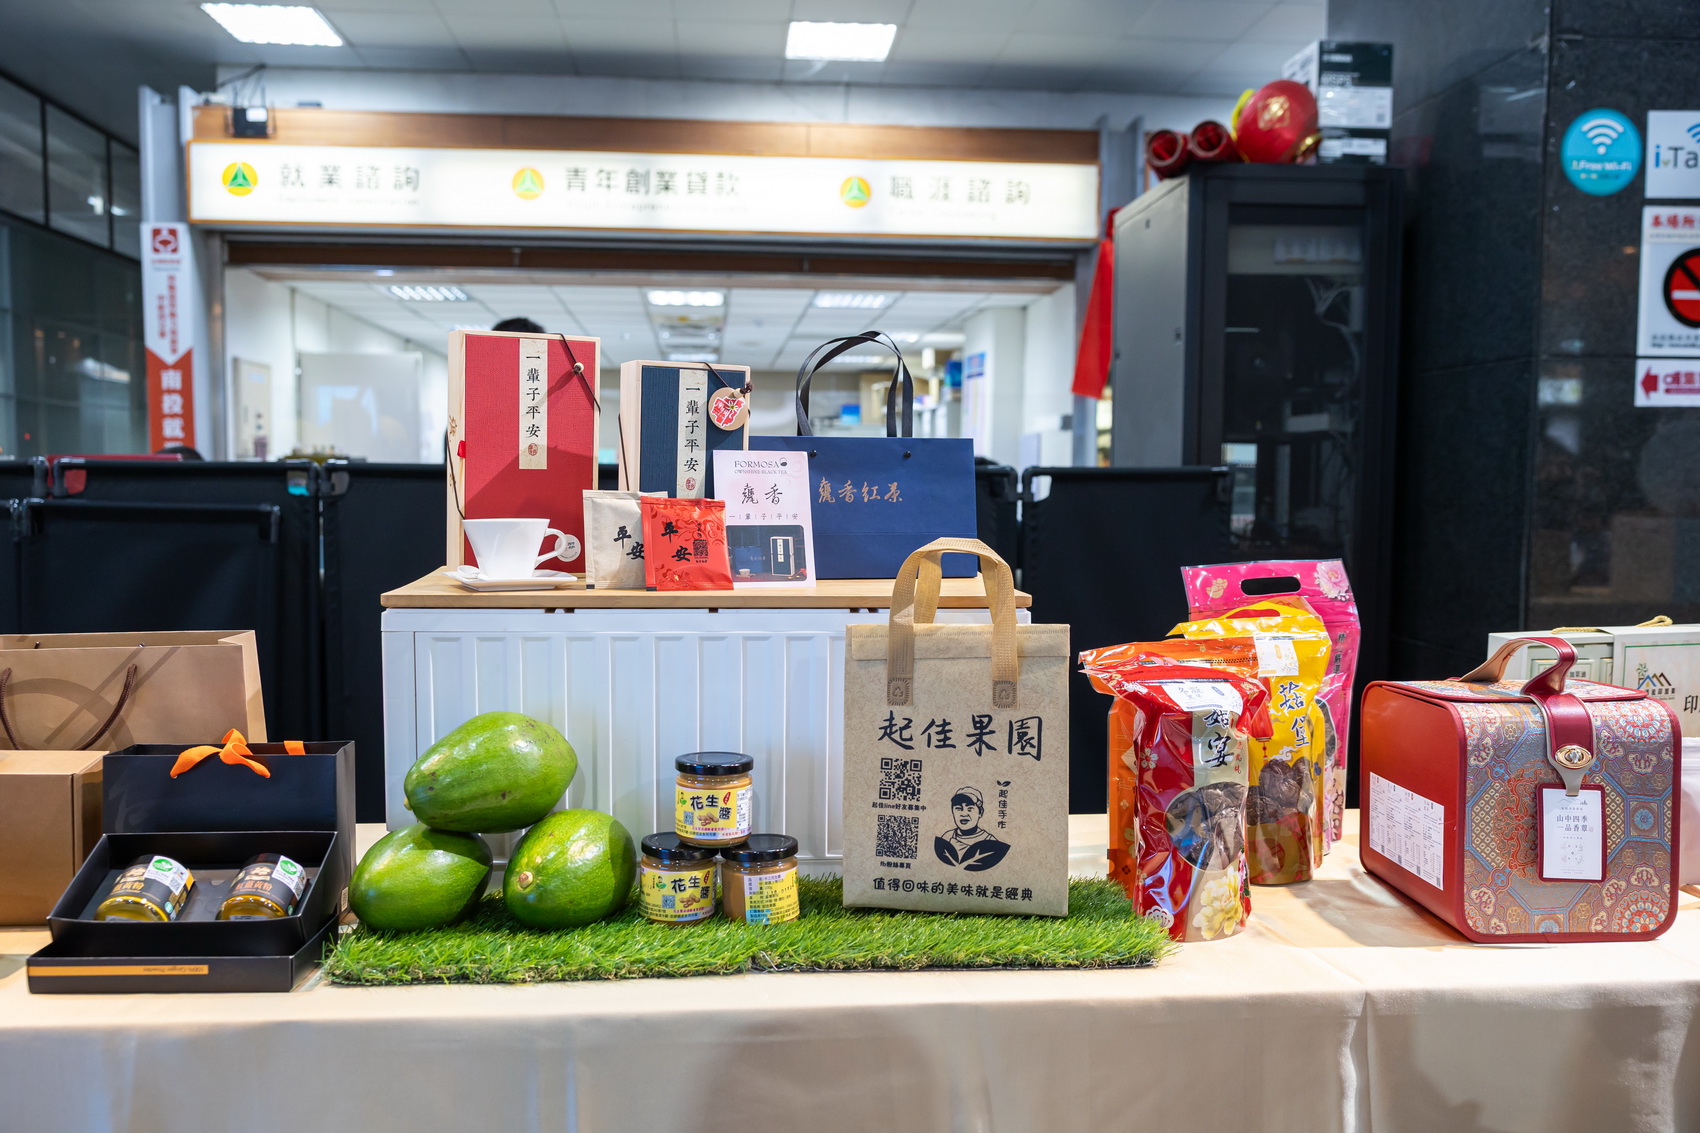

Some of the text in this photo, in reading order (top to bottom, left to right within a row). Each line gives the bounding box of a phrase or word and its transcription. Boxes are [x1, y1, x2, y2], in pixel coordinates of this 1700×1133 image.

[279, 162, 421, 193] 就業諮詢
[566, 166, 740, 196] 青年創業貸款
[525, 354, 541, 438] 一輩子平安
[683, 386, 701, 473] 一輩子平安
[734, 460, 780, 468] FORMOSA
[877, 709, 1043, 762] 起佳果園
[997, 789, 1009, 829] 起佳手作
[1556, 814, 1588, 823] 山中四季
[872, 876, 1034, 902] 值得回味的美味就是經典
